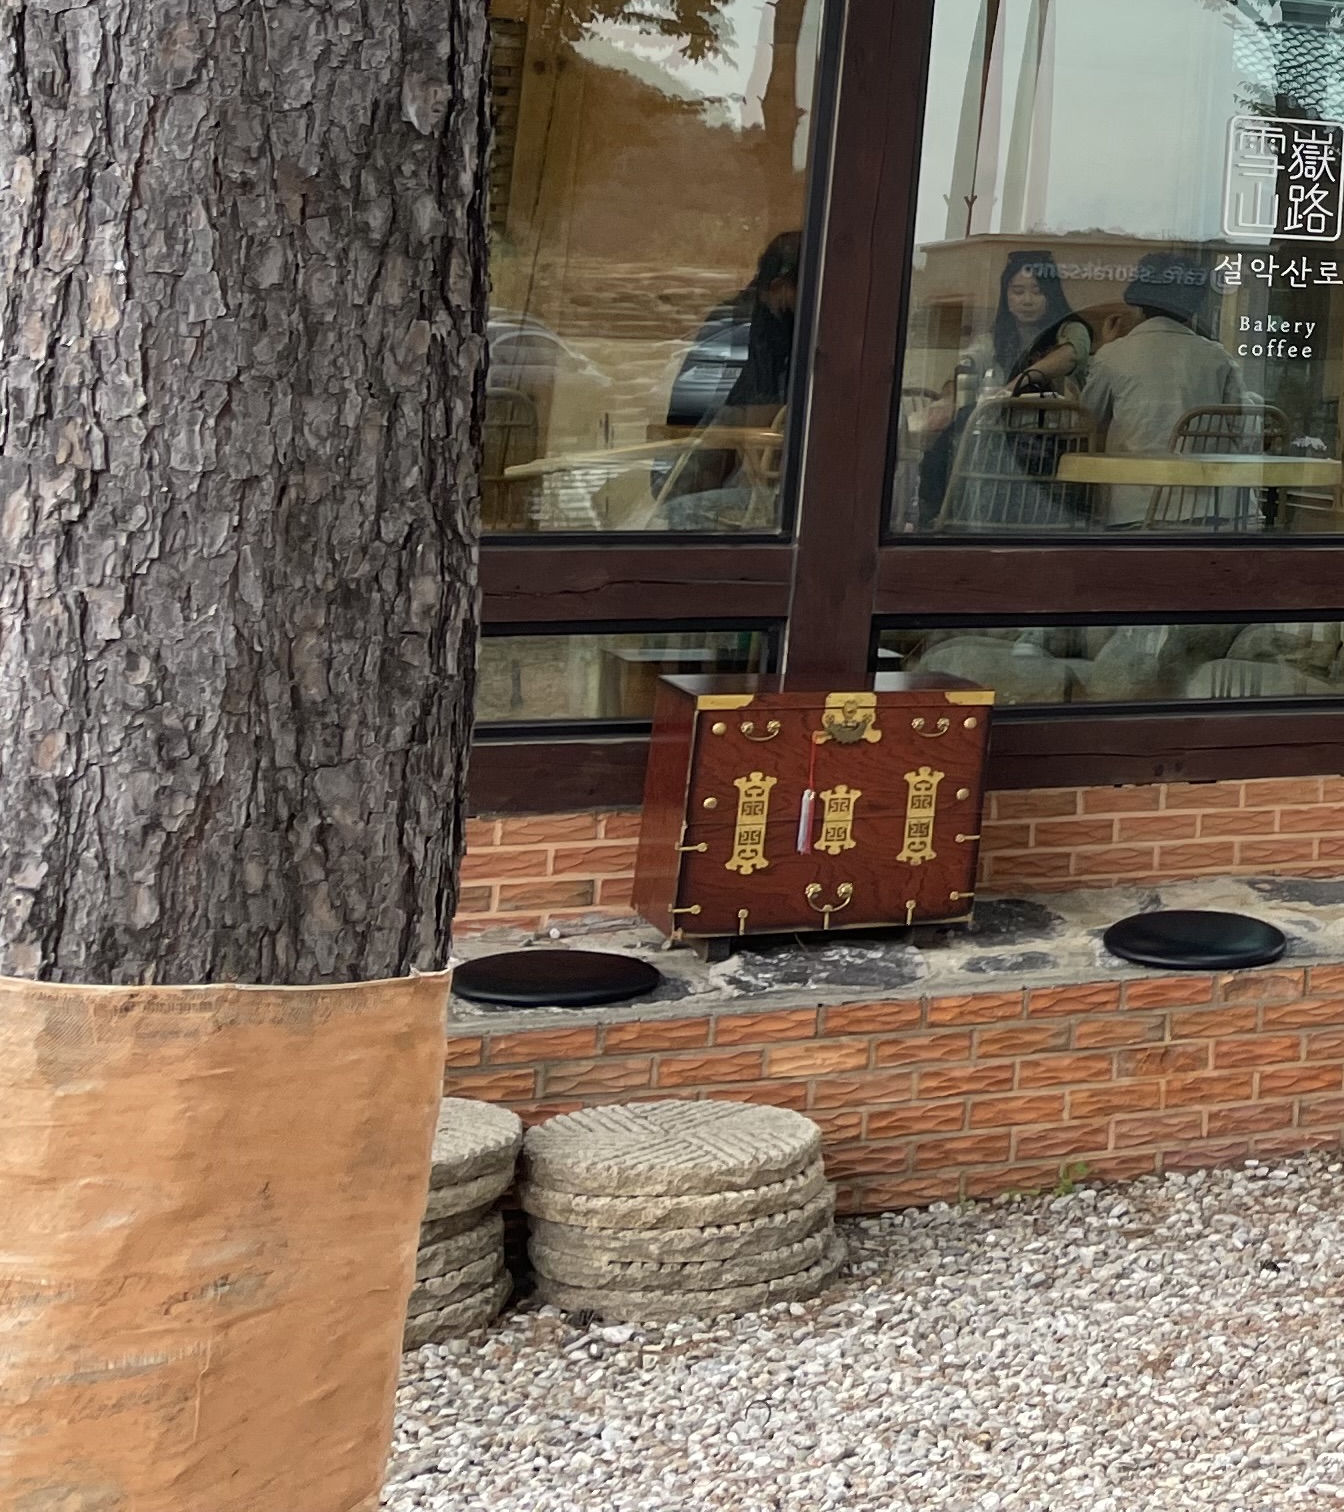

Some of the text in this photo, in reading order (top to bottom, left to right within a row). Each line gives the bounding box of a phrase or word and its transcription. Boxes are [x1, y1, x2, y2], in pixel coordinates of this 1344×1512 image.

[1214, 253, 1344, 288] 설악산로
[1239, 315, 1316, 337] Bakery
[1237, 339, 1313, 358] coffee
